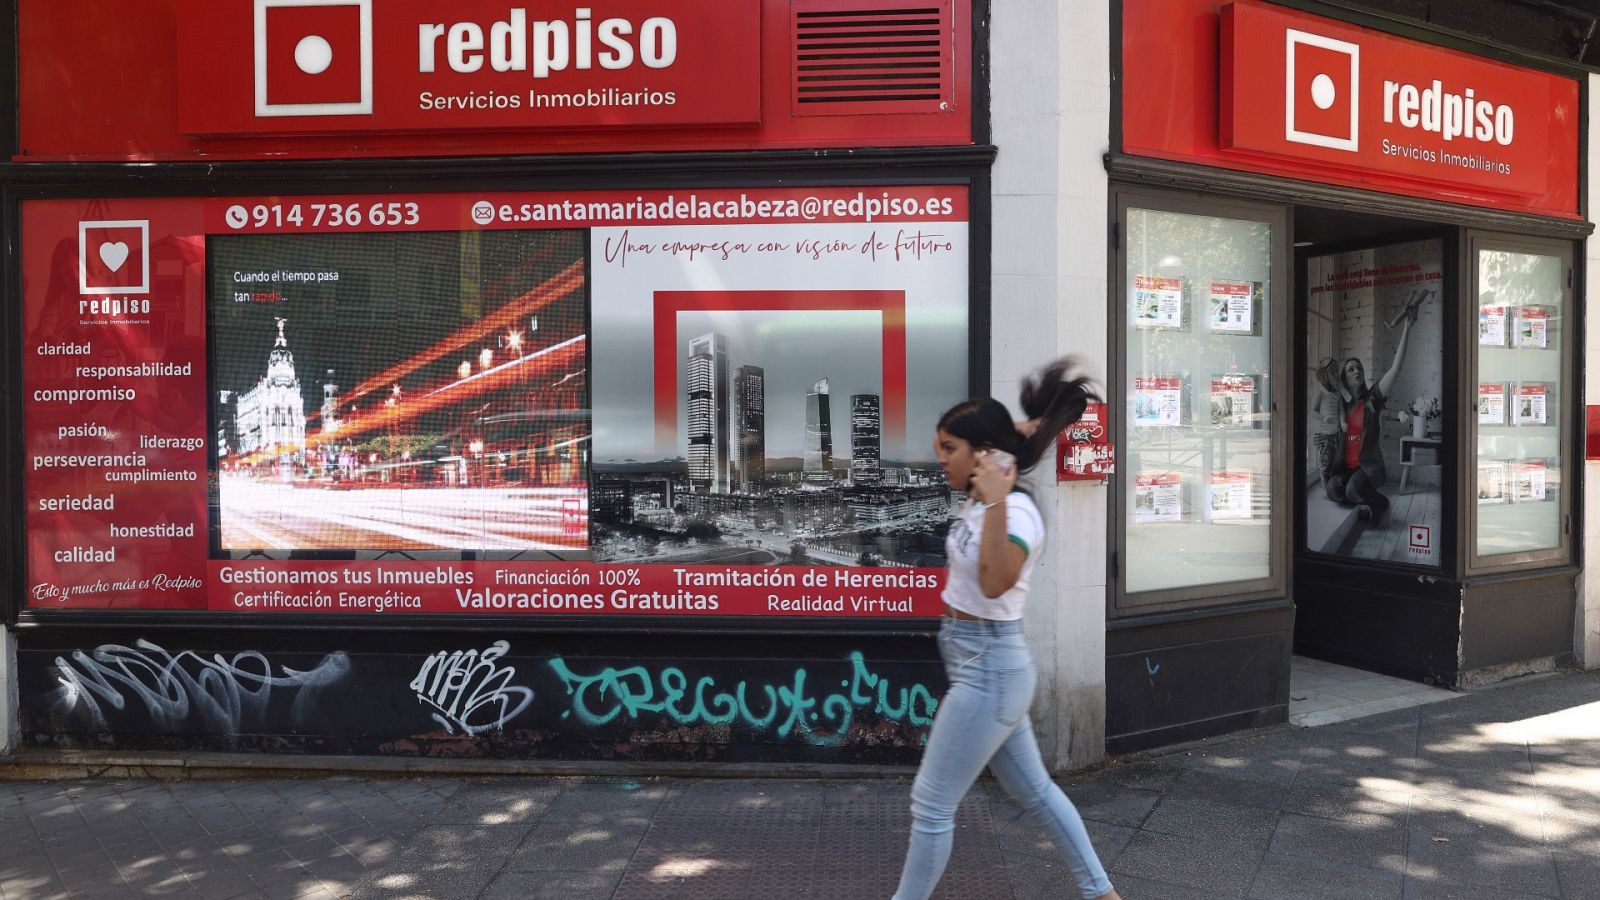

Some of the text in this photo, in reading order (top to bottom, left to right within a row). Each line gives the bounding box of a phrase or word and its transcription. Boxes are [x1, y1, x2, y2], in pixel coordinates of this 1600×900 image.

[418, 8, 678, 79] redpiso
[419, 87, 677, 110] Servicios Inmobiliarios
[1382, 79, 1515, 146] redpiso
[1382, 138, 1512, 175] Servicios Inmobiliarios
[252, 202, 420, 228] 914 736 653
[498, 192, 954, 222] e.santamariadelacabeza@redpiso.es
[604, 229, 953, 268] Una empresa con visión de futuro
[233, 270, 340, 285] Cuando el tiempo pasa
[79, 296, 150, 317] redpiso
[234, 291, 250, 303] tan
[37, 341, 92, 356] claridad
[75, 361, 192, 380] responsabilidad
[33, 385, 136, 405] compromiso
[58, 422, 107, 440] pasión
[140, 434, 204, 451] liderazgo
[33, 451, 146, 471] perseverancia
[105, 468, 198, 484] cumplimiento
[39, 493, 115, 511] seriedad
[110, 522, 194, 538] honestidad
[54, 545, 115, 563] calidad
[219, 566, 474, 585] Gestionamos tus Inmuebles
[495, 567, 641, 586] Financiación 100%
[673, 568, 938, 588] Tramitación de Herencias
[32, 573, 203, 602] Esto y mucho más es Redpiso
[233, 589, 422, 613] Certificación Energética
[455, 587, 720, 610] Valoraciones Gratuitas
[767, 595, 914, 613] Realidad Virtual
